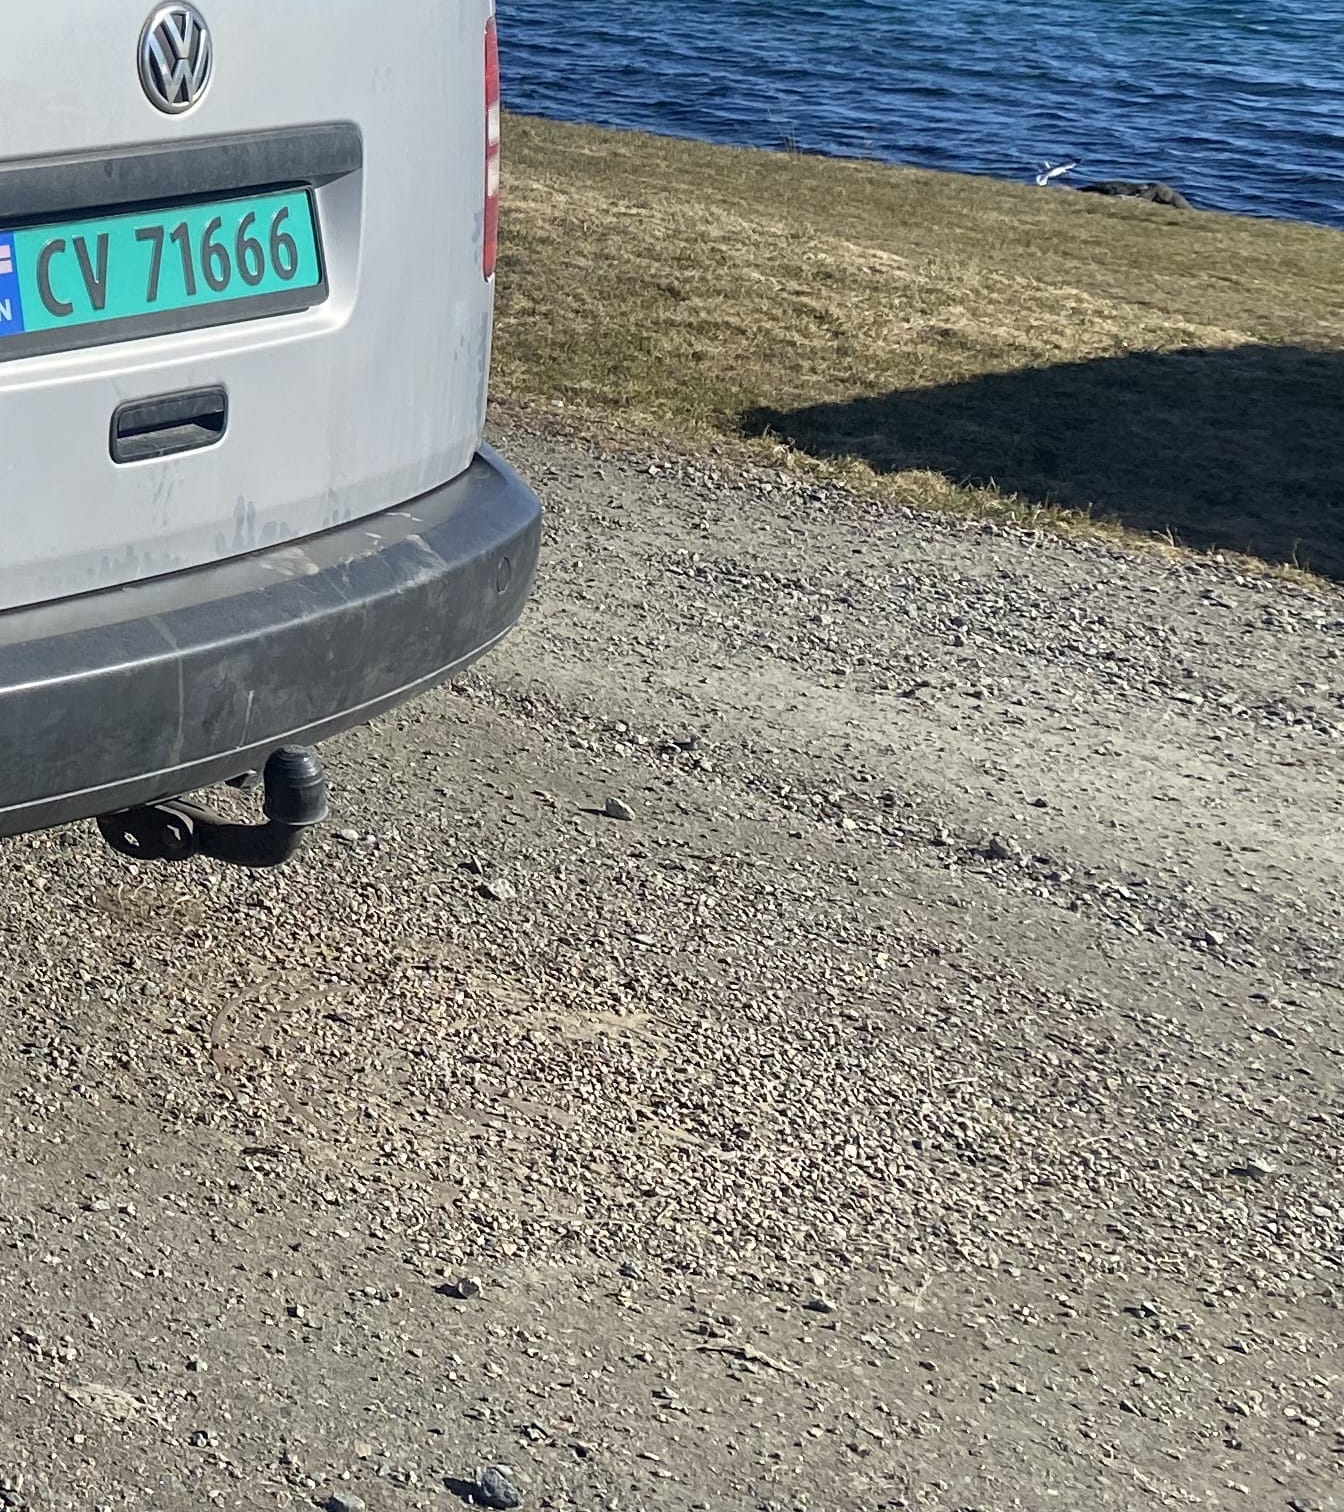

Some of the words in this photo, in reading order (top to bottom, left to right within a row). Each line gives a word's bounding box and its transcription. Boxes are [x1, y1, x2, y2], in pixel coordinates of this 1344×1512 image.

[143, 3, 210, 109] VW
[36, 232, 110, 318] CV
[134, 205, 299, 303] 71666
